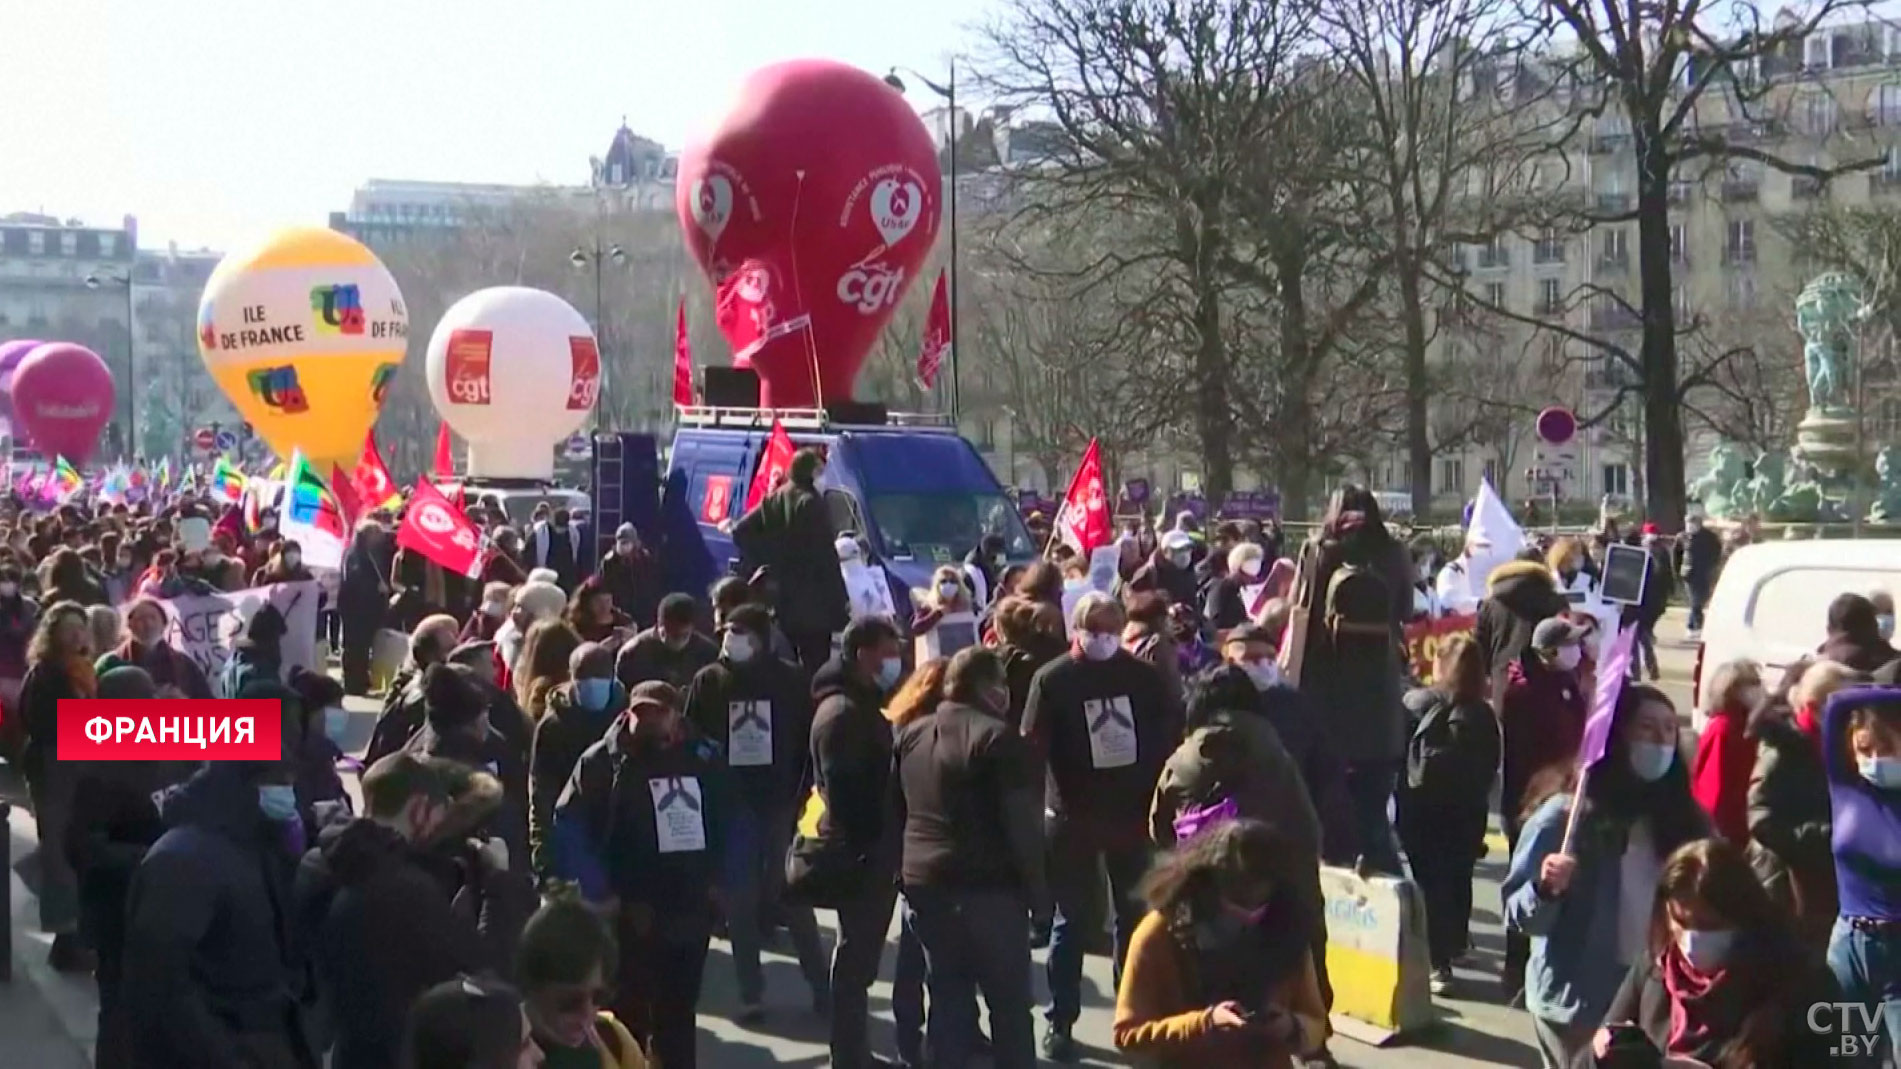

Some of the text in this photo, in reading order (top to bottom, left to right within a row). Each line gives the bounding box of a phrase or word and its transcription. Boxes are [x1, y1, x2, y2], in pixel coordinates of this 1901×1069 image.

[243, 305, 266, 323] ILE
[221, 324, 305, 350] DE FRANCE
[372, 320, 386, 338] DE
[452, 374, 489, 402] cgt
